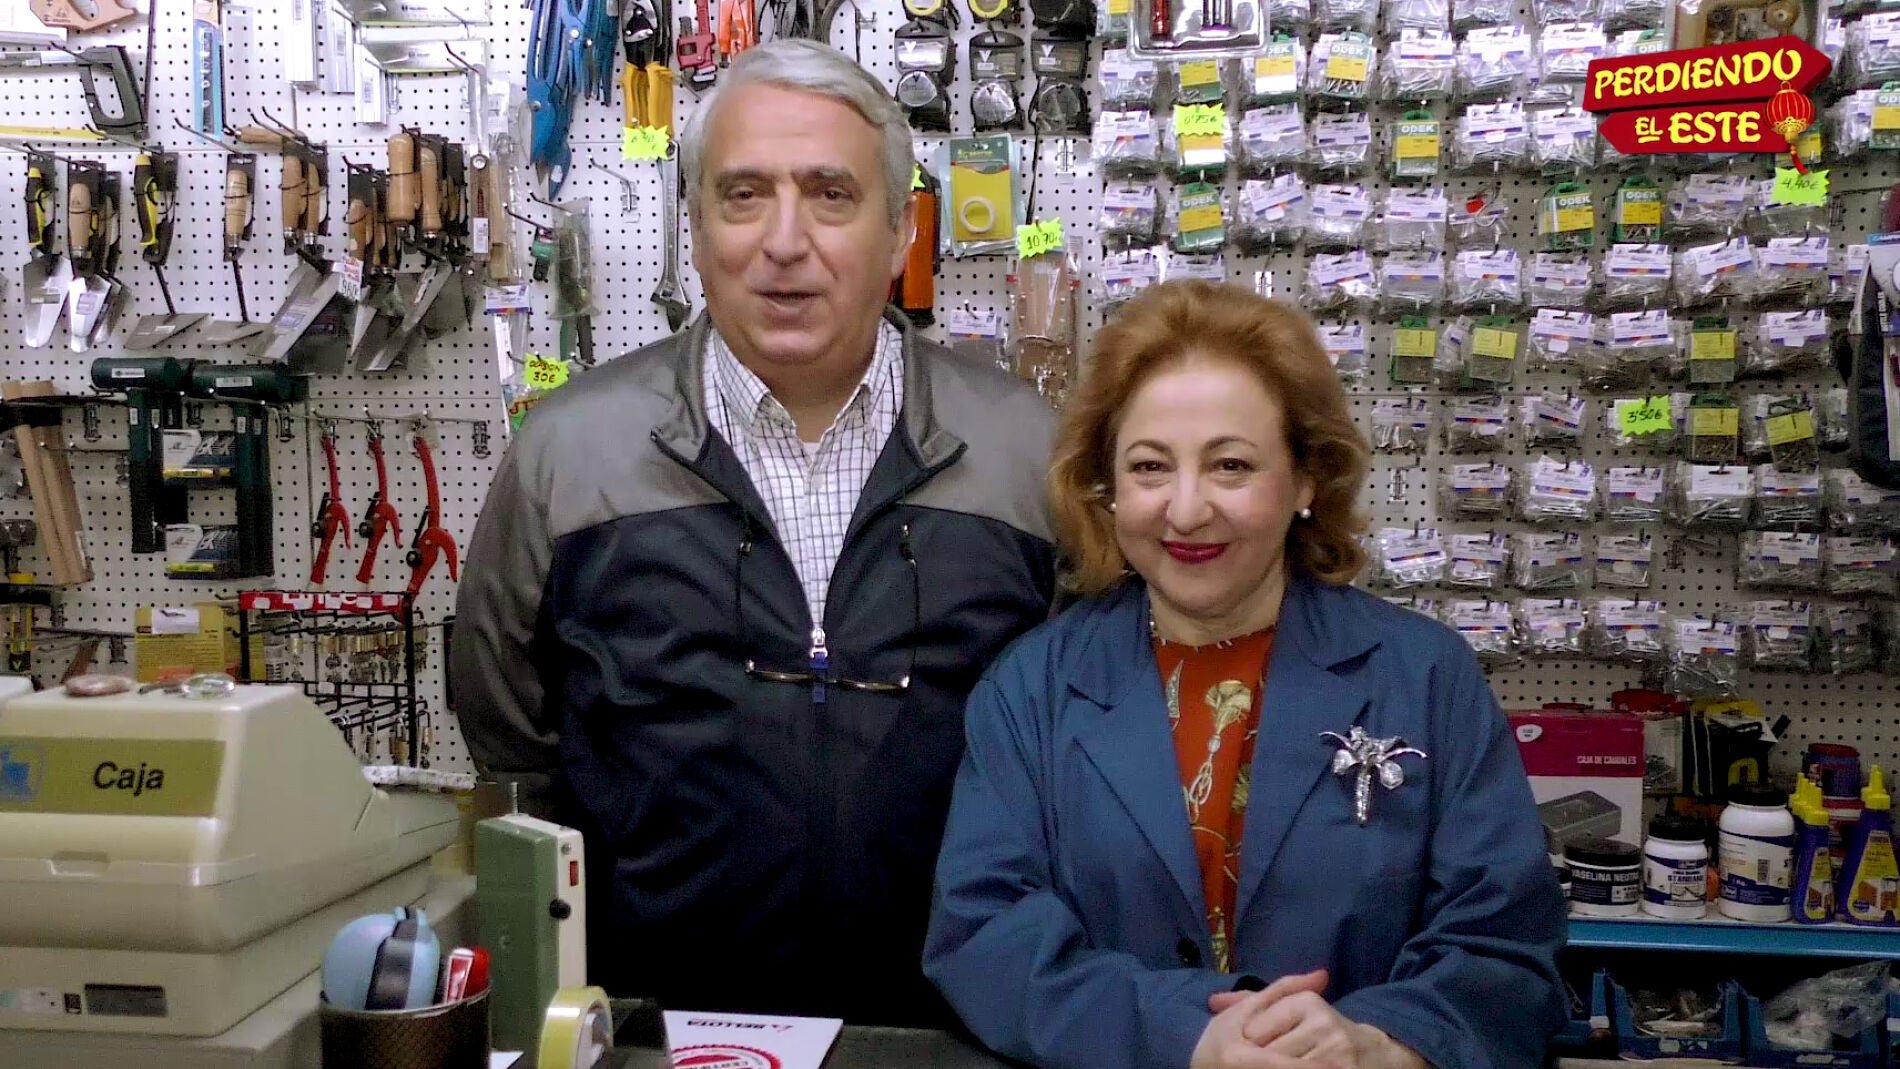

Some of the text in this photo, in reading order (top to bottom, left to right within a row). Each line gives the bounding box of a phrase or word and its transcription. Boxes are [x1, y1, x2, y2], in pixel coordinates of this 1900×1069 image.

[1331, 45, 1365, 54] ODEK
[1401, 124, 1435, 133] ODEK
[1626, 191, 1657, 199] ODEK
[1560, 196, 1591, 206] ODEK
[93, 760, 165, 797] Caja
[687, 1019, 767, 1029] BELLOTA
